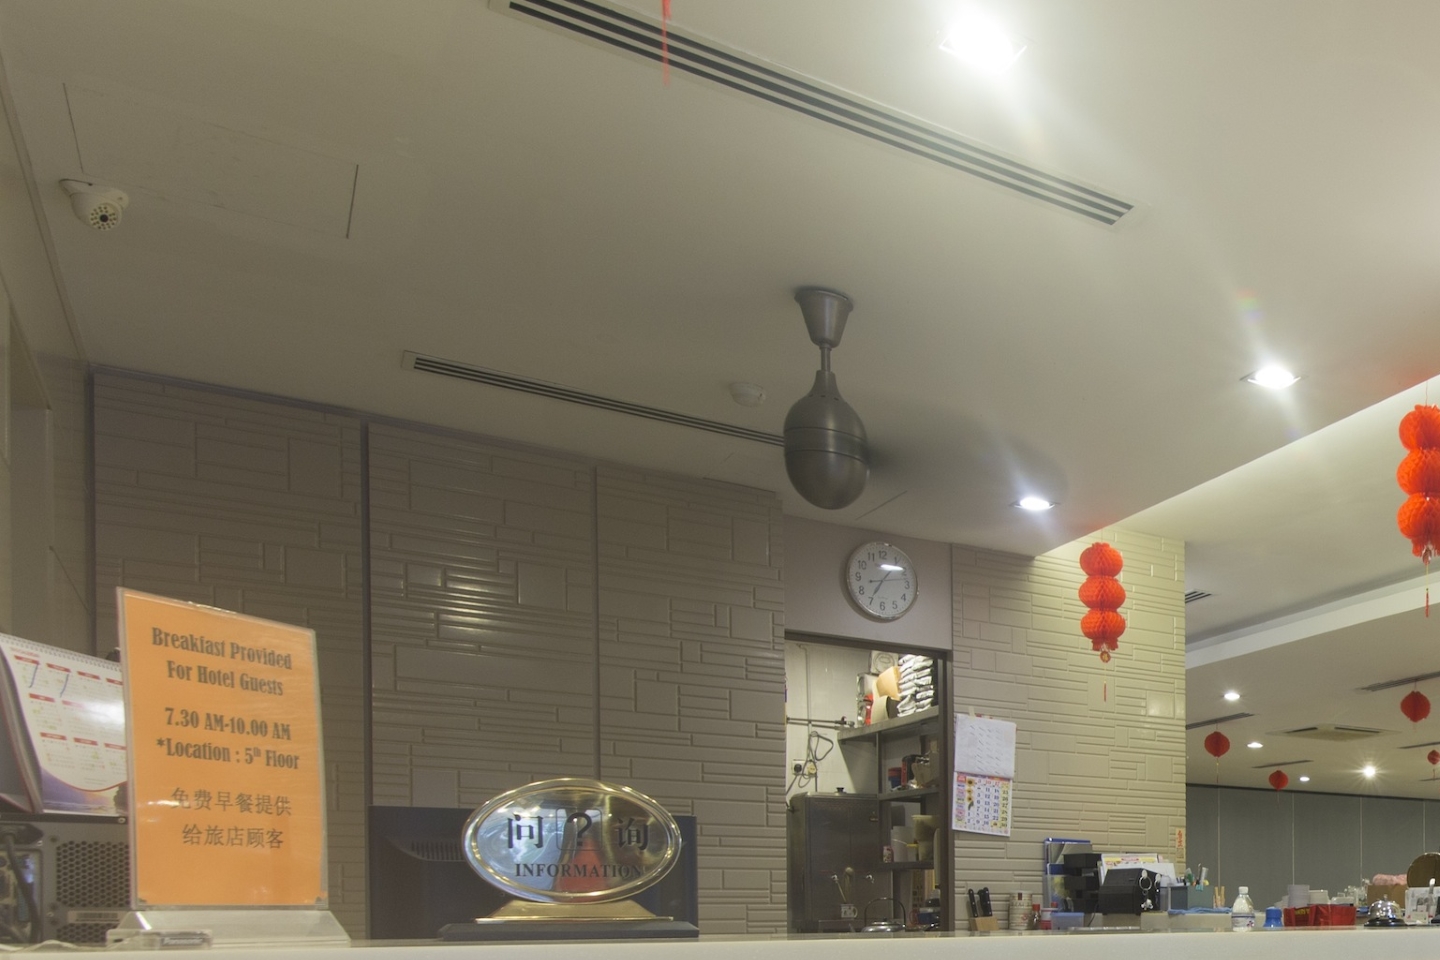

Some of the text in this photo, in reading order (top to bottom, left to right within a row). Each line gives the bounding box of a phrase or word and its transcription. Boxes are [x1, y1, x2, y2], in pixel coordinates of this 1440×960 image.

[867, 552, 875, 562] 11
[878, 550, 887, 560] 12
[857, 560, 867, 570] 10
[855, 572, 861, 581] 9
[904, 580, 910, 589] 3
[858, 586, 864, 595] 8
[868, 597, 874, 605] 7
[901, 593, 906, 602] 4
[880, 601, 885, 611] 6
[892, 601, 898, 609] 5
[152, 627, 292, 670] Breakfast Provided
[167, 660, 284, 696] For Hotel Guests
[165, 707, 292, 741] 7.30 AM-10.00 AM
[265, 749, 300, 769] Floor
[170, 787, 292, 816] 免费早餐提供
[182, 824, 284, 849] 给旅店顾客
[507, 813, 543, 849] 问
[616, 817, 649, 851] 询
[515, 863, 645, 878] INFORMATION
